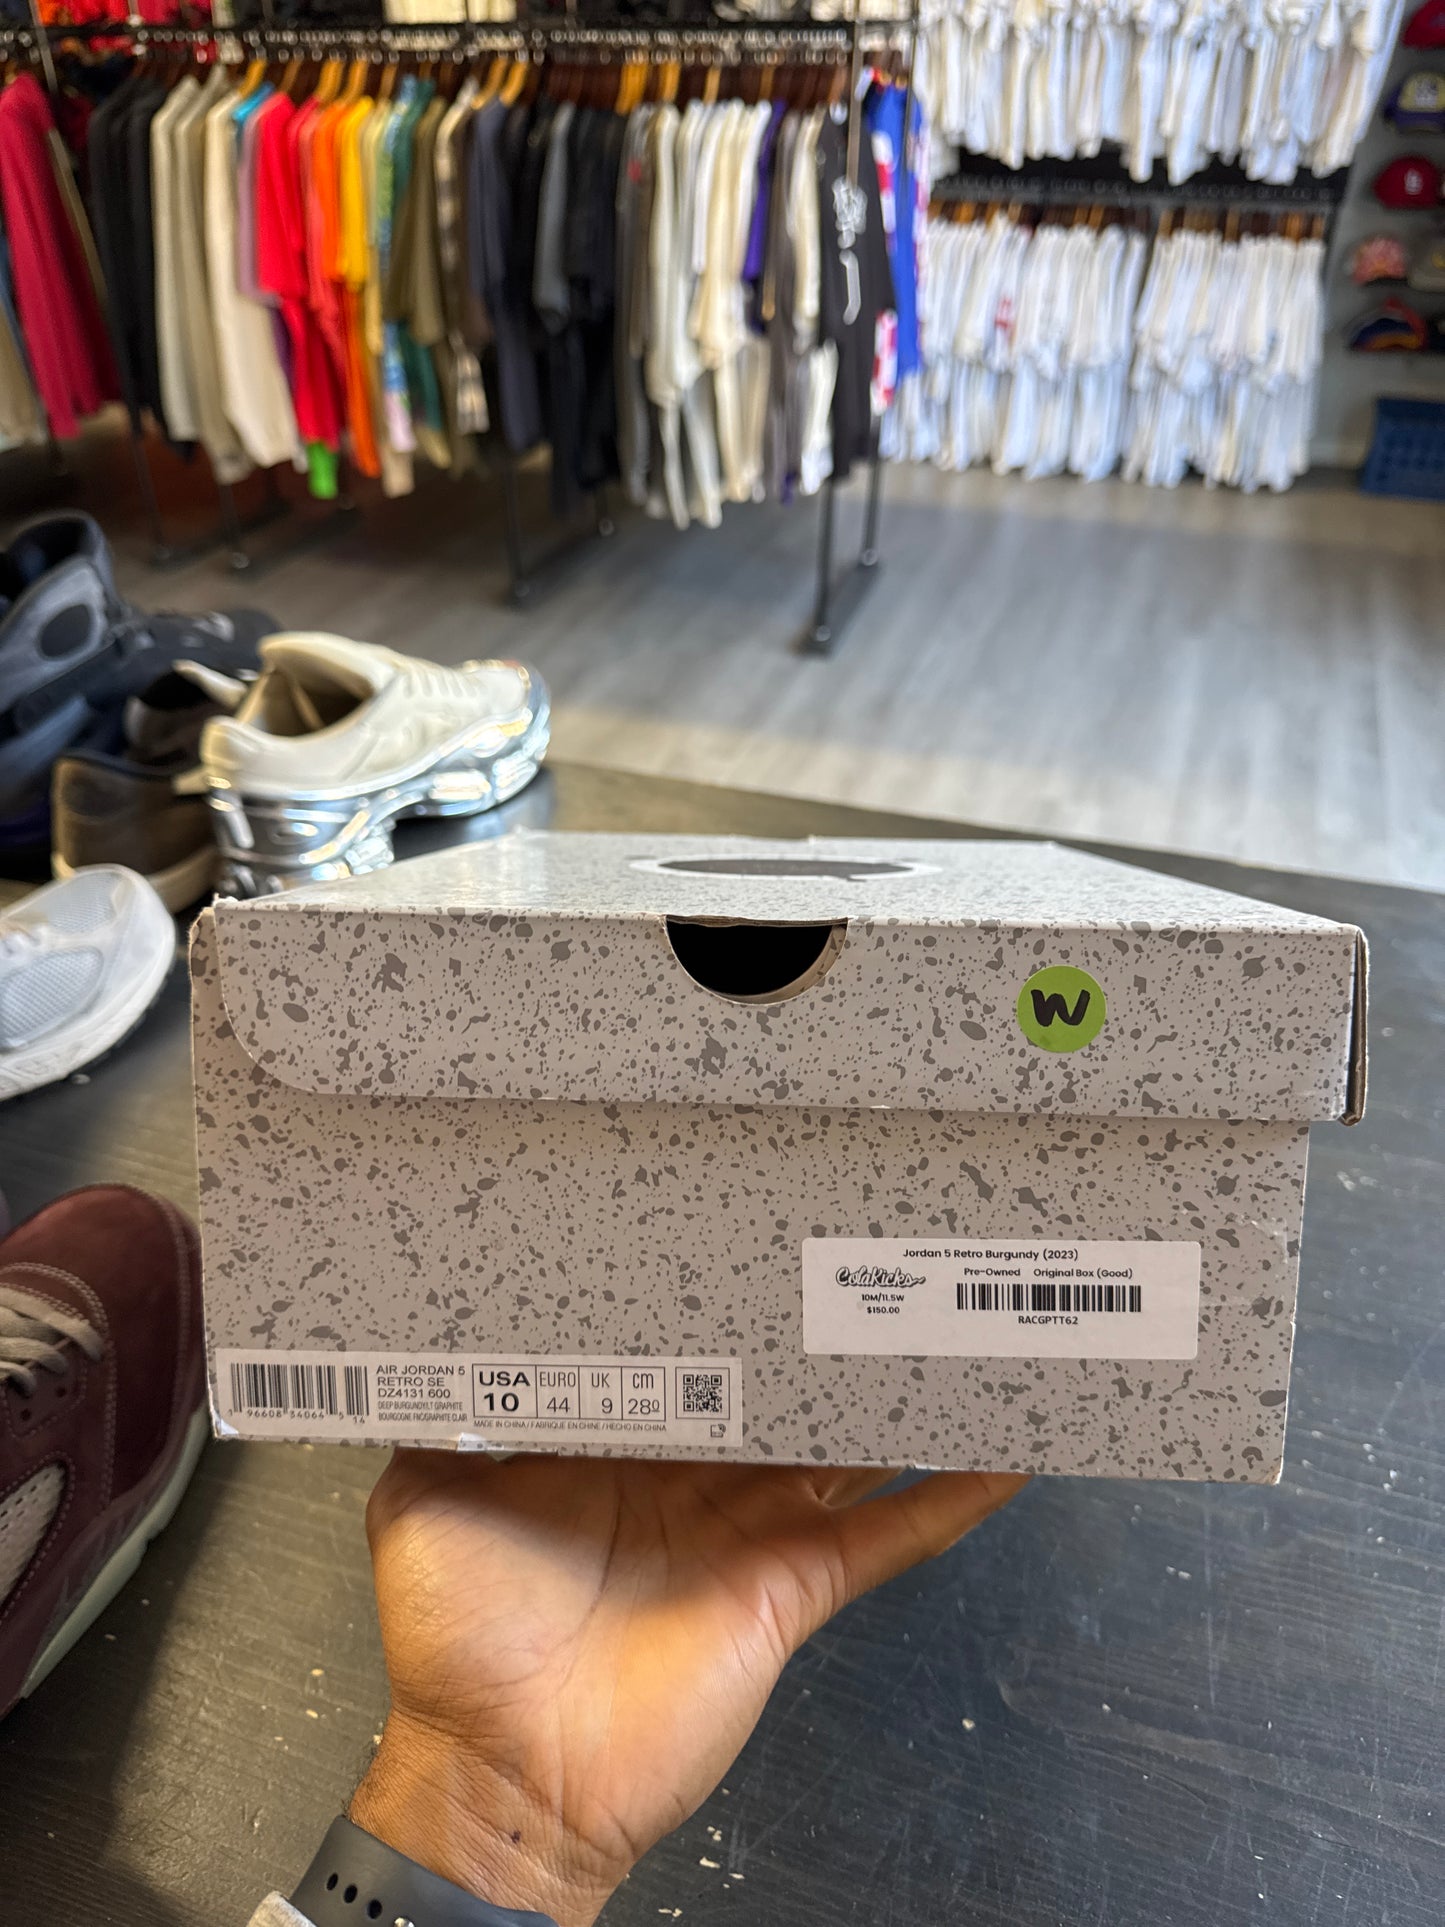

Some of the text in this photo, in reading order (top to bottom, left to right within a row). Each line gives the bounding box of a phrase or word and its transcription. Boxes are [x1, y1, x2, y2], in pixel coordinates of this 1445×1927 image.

[903, 1248, 1079, 1261] Jordan 5 Retro Burgundy (2023)
[963, 1267, 1133, 1279] Pre-Owned Original Box (Good)
[867, 1306, 900, 1314] $150.00
[1018, 1315, 1079, 1325] RACGPTT62
[376, 1365, 466, 1375] AIR JORDAN 5
[377, 1376, 445, 1387] RETRO SE
[479, 1371, 531, 1387] USA
[539, 1371, 576, 1388] EURO
[591, 1372, 610, 1389] UK
[378, 1388, 451, 1398] DZ4131 600
[378, 1401, 394, 1410] DEEP
[434, 1401, 463, 1411] GRAPHITE
[483, 1393, 519, 1412] 10
[546, 1397, 570, 1413] 44
[601, 1397, 613, 1414] 9
[474, 1420, 492, 1428] MADE
